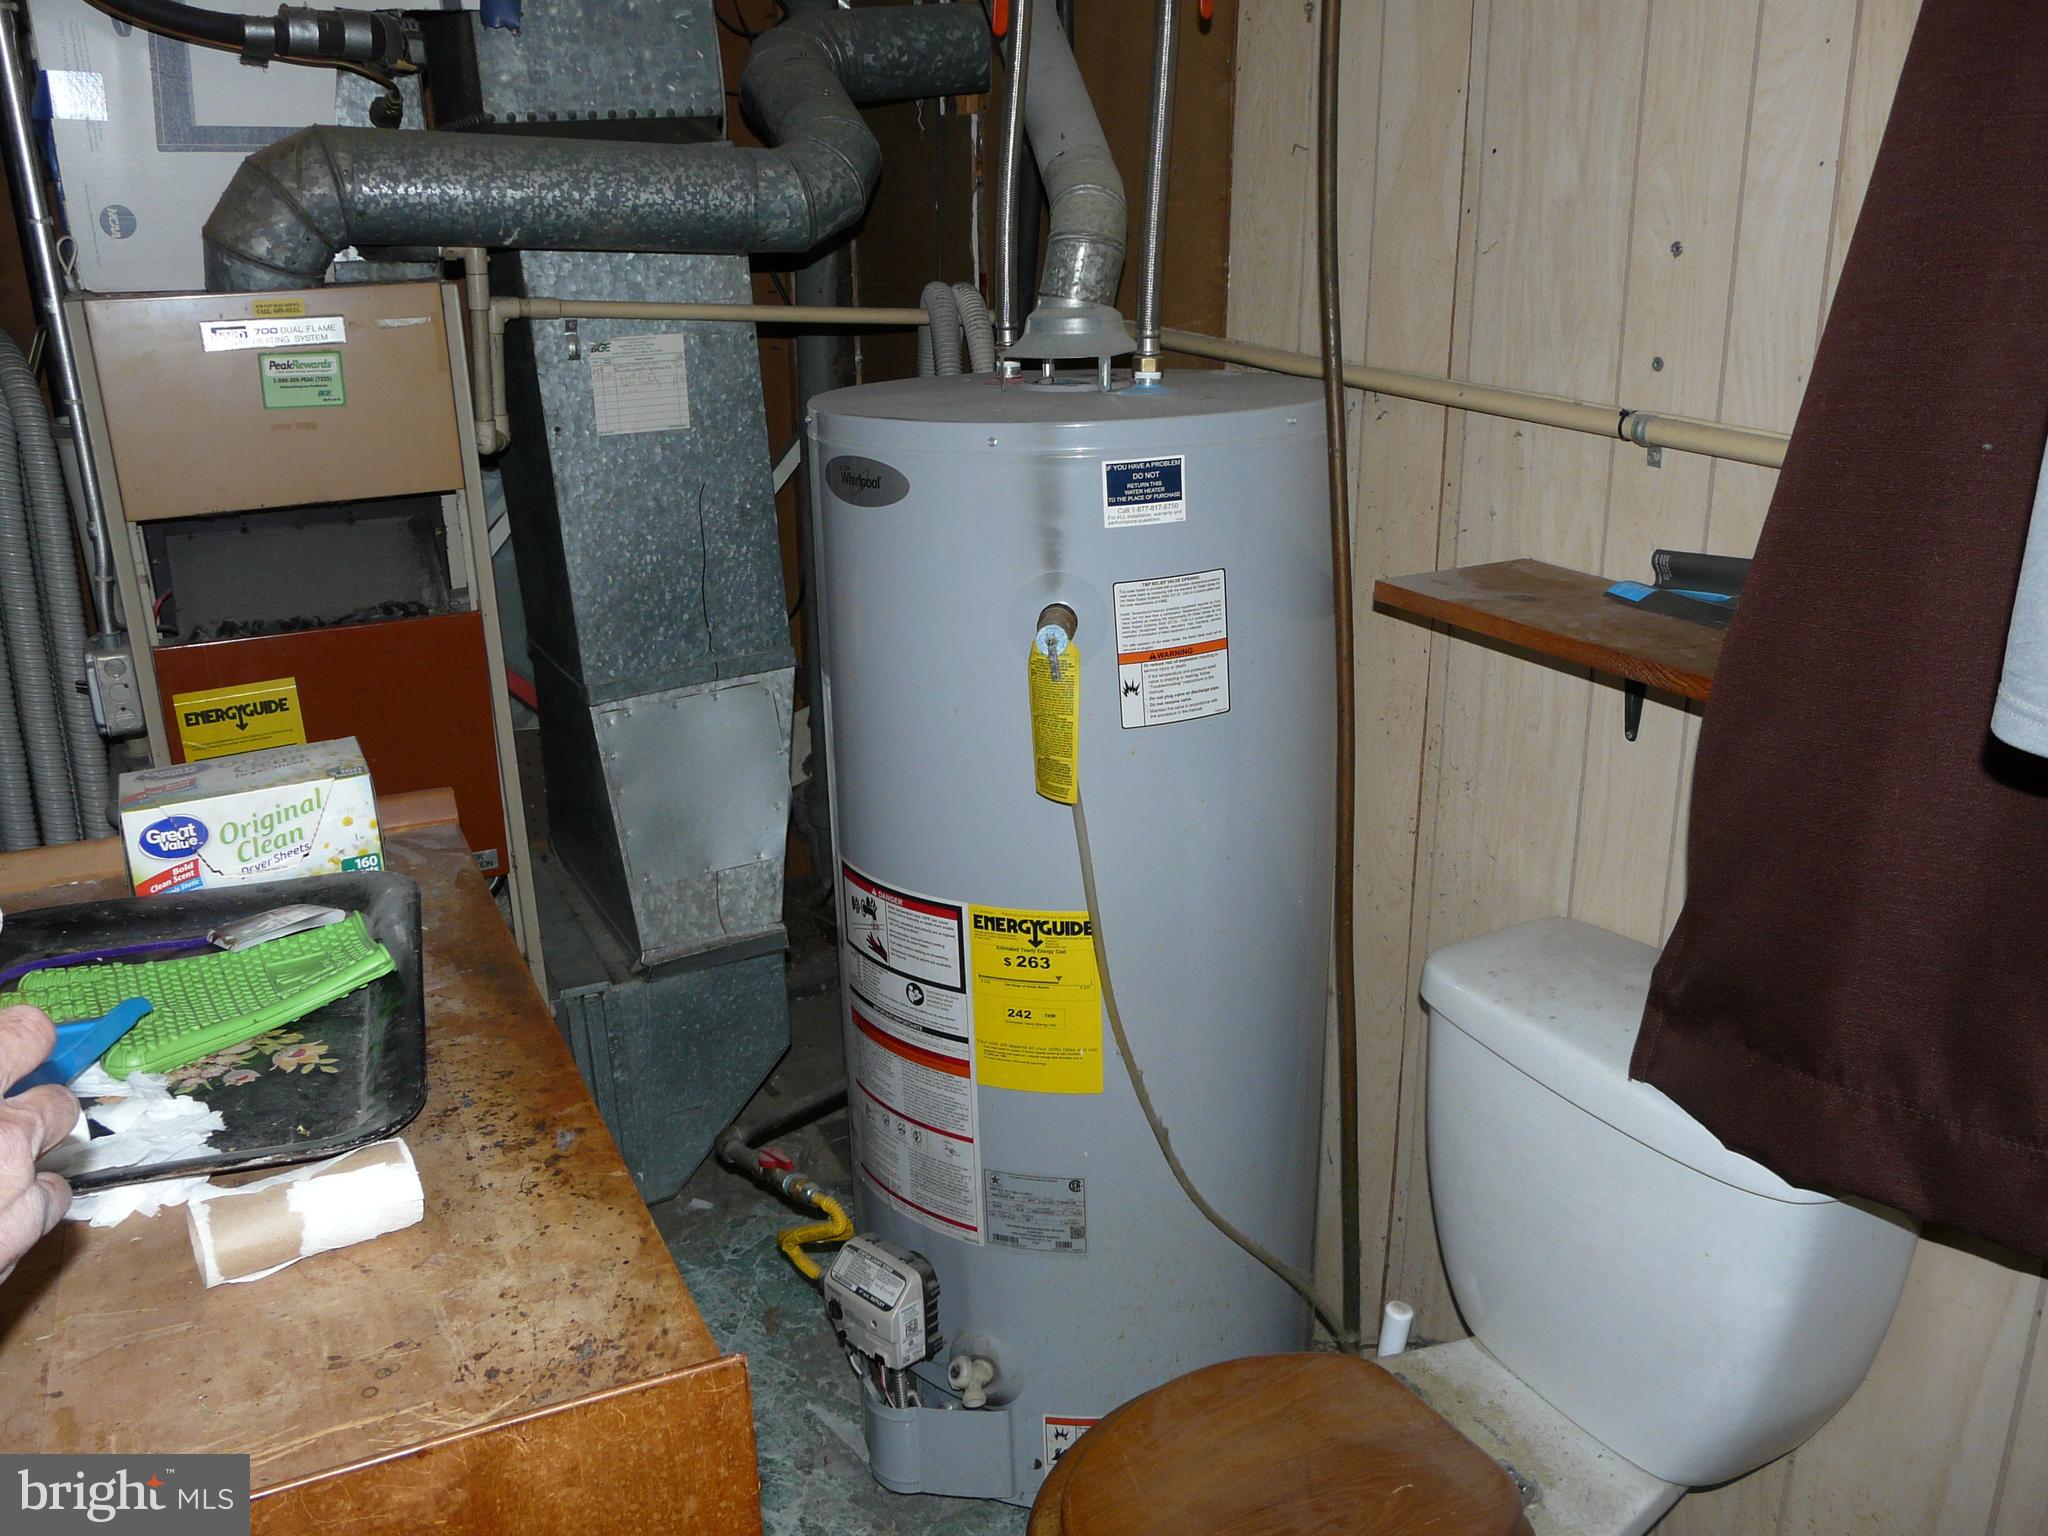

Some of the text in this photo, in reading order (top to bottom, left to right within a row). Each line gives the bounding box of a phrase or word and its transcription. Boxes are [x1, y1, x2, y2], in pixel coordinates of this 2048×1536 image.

[253, 327, 279, 335] 700
[280, 326, 303, 334] DUAL
[306, 324, 336, 333] FLAME
[294, 334, 329, 343] SYSTEM
[590, 342, 612, 353] BGE
[269, 357, 332, 371] PeakRewards
[1151, 459, 1181, 467] PROBLEM
[840, 470, 881, 492] Whirlpool
[1132, 471, 1160, 480] DO NOT
[1124, 486, 1165, 496] WATER HEATER
[1153, 491, 1181, 499] PURCHASE
[1157, 647, 1193, 659] WARNING
[184, 697, 290, 728] ENERGYGUIDE
[219, 786, 322, 845] Original
[145, 822, 198, 843] Great
[158, 836, 199, 852] Value
[236, 826, 304, 863] Clean
[273, 842, 311, 863] Sheets
[172, 861, 194, 875] Bold
[354, 855, 378, 869] 160
[150, 880, 172, 894] Clean
[172, 870, 196, 884] Scent
[878, 890, 904, 906] DANGER
[973, 913, 1092, 937] ENERGYGUIDE
[996, 945, 1019, 953] Estimated
[1020, 947, 1036, 955] Yearly
[1003, 955, 1051, 970] $ 263
[1007, 1008, 1032, 1019] 242
